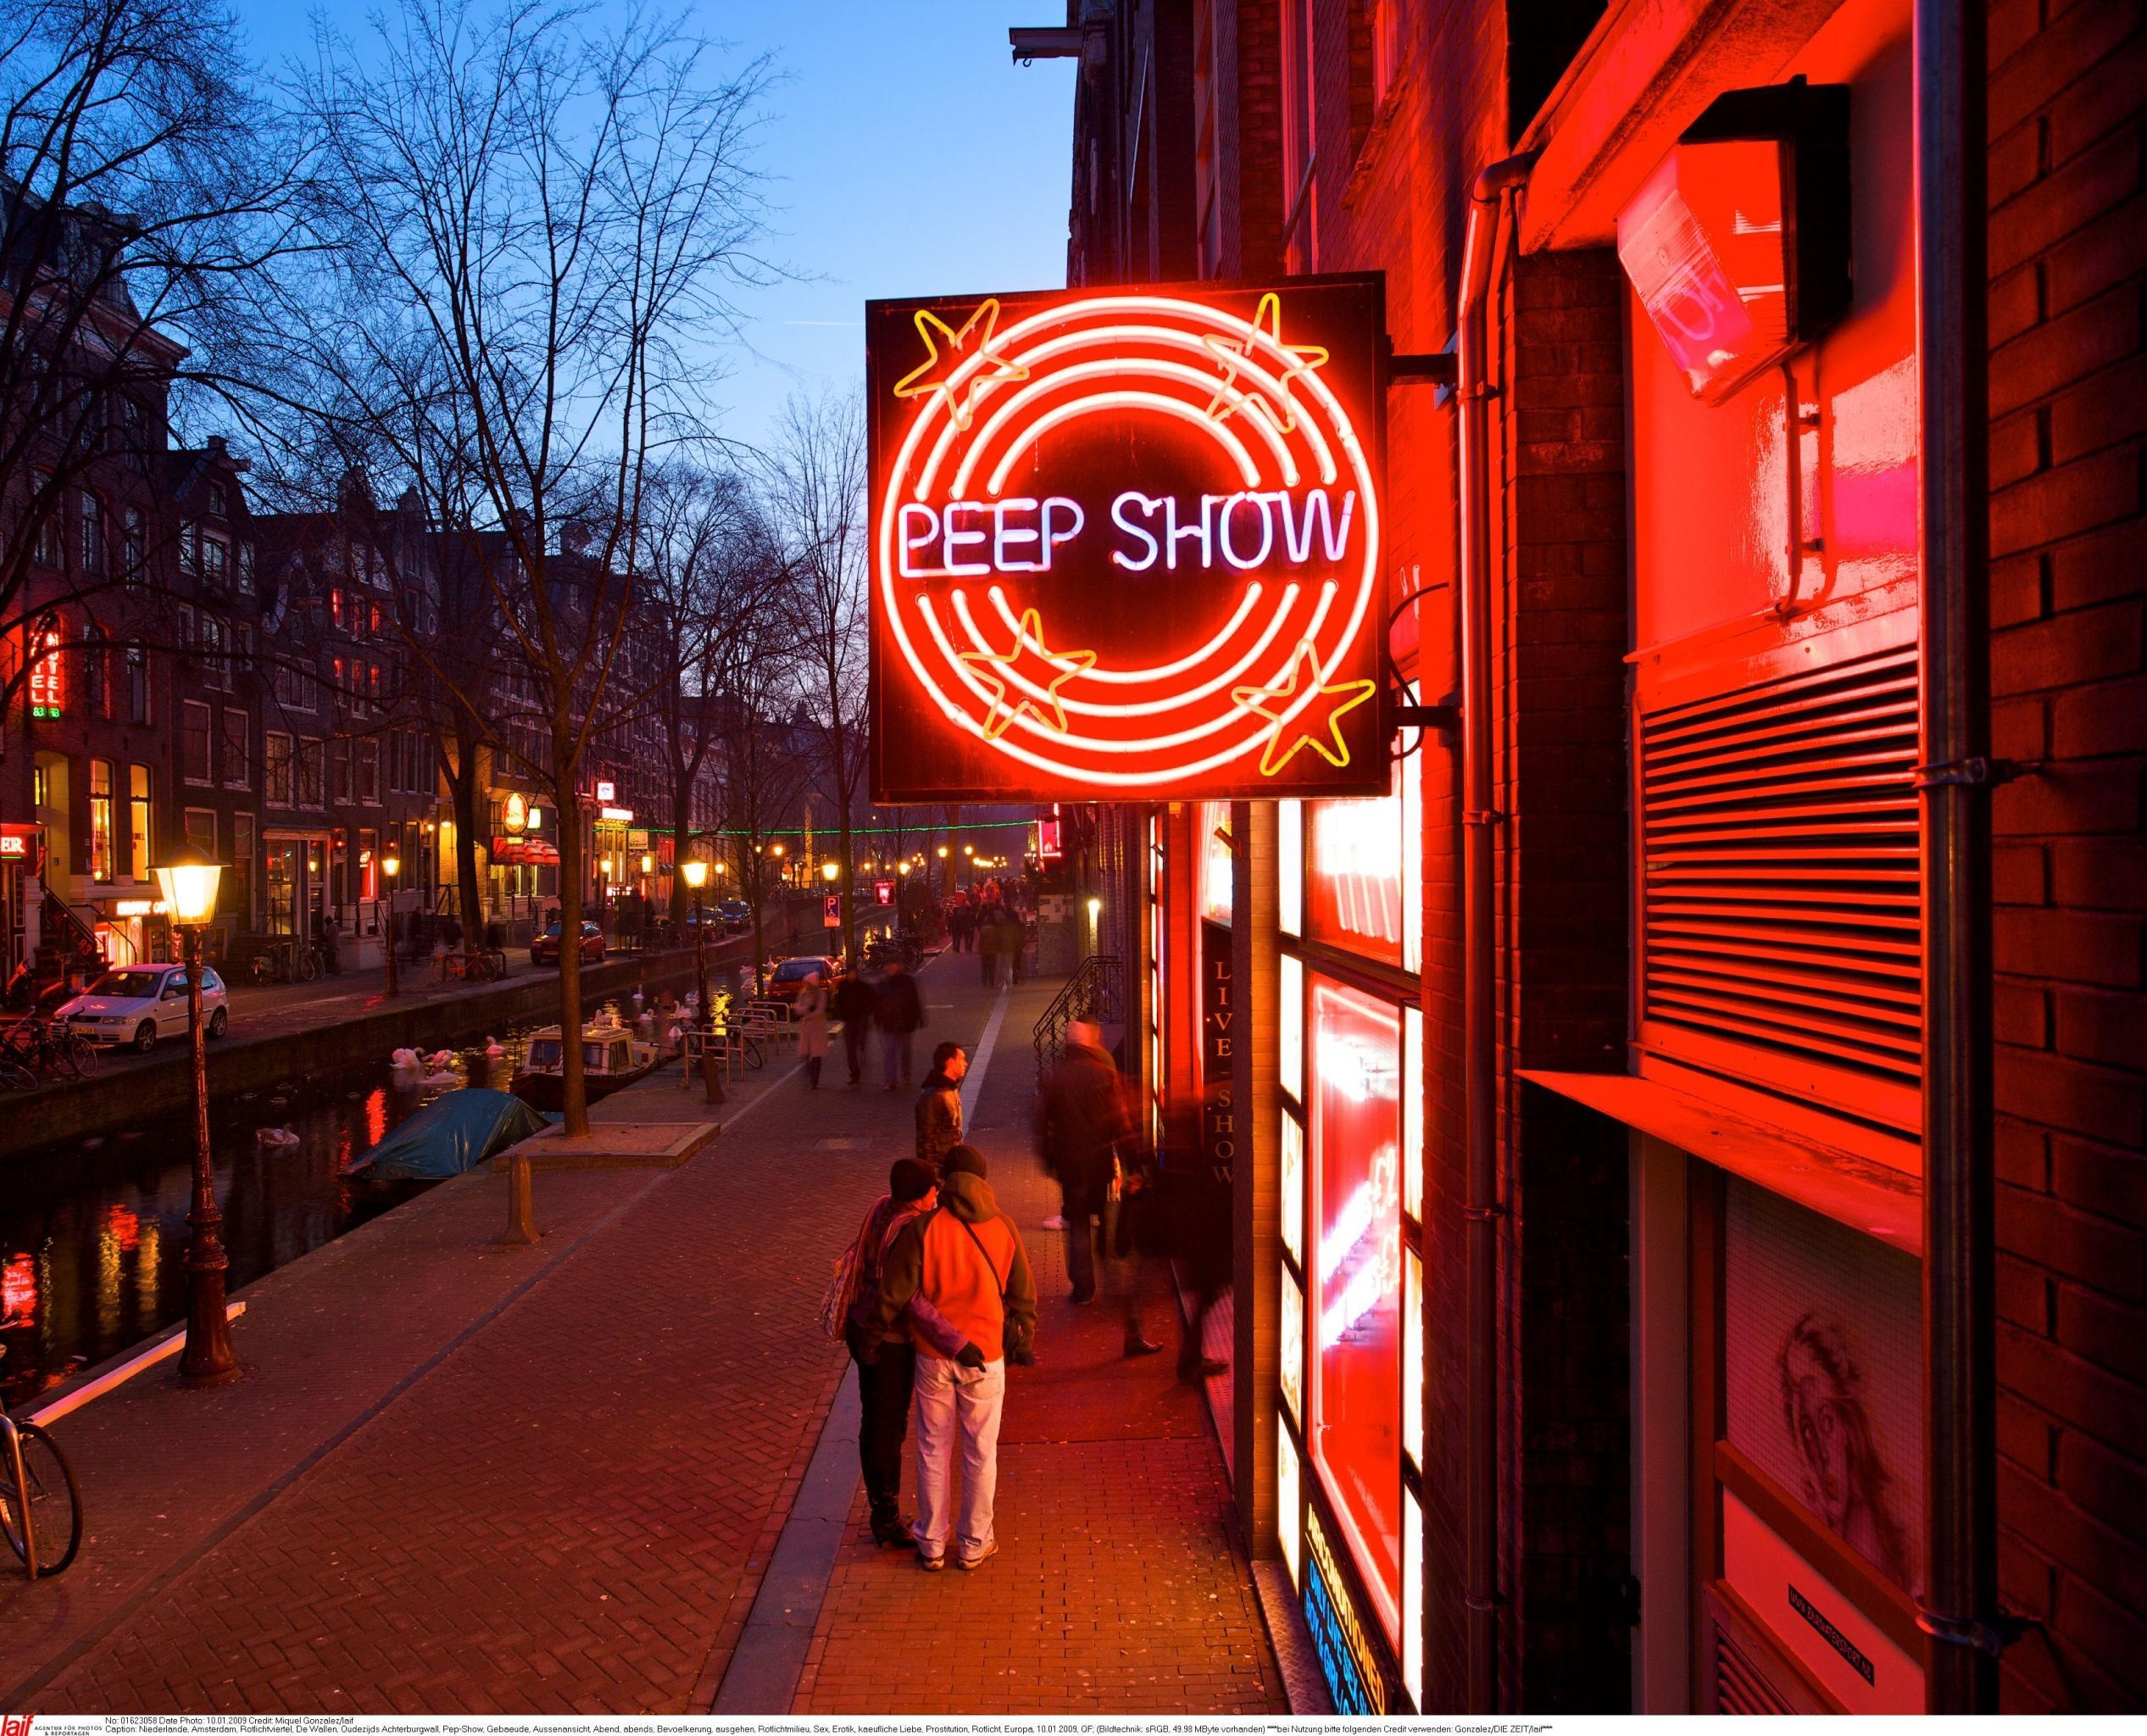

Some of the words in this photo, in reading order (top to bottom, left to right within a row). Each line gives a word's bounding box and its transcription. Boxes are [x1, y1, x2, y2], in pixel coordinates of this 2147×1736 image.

[898, 496, 1085, 579] PEEP
[1107, 488, 1355, 572] SHOW
[827, 897, 837, 910] P
[1215, 961, 1233, 1057] LIVE
[1213, 1088, 1234, 1182] SHOW
[1305, 1589, 1320, 1643] BOY
[1308, 1502, 1385, 1715] AIRCONDITIONED
[1310, 1559, 1327, 1618] ONLY
[1327, 1601, 1343, 1666] LIVE
[1343, 1646, 1359, 1711] SEX
